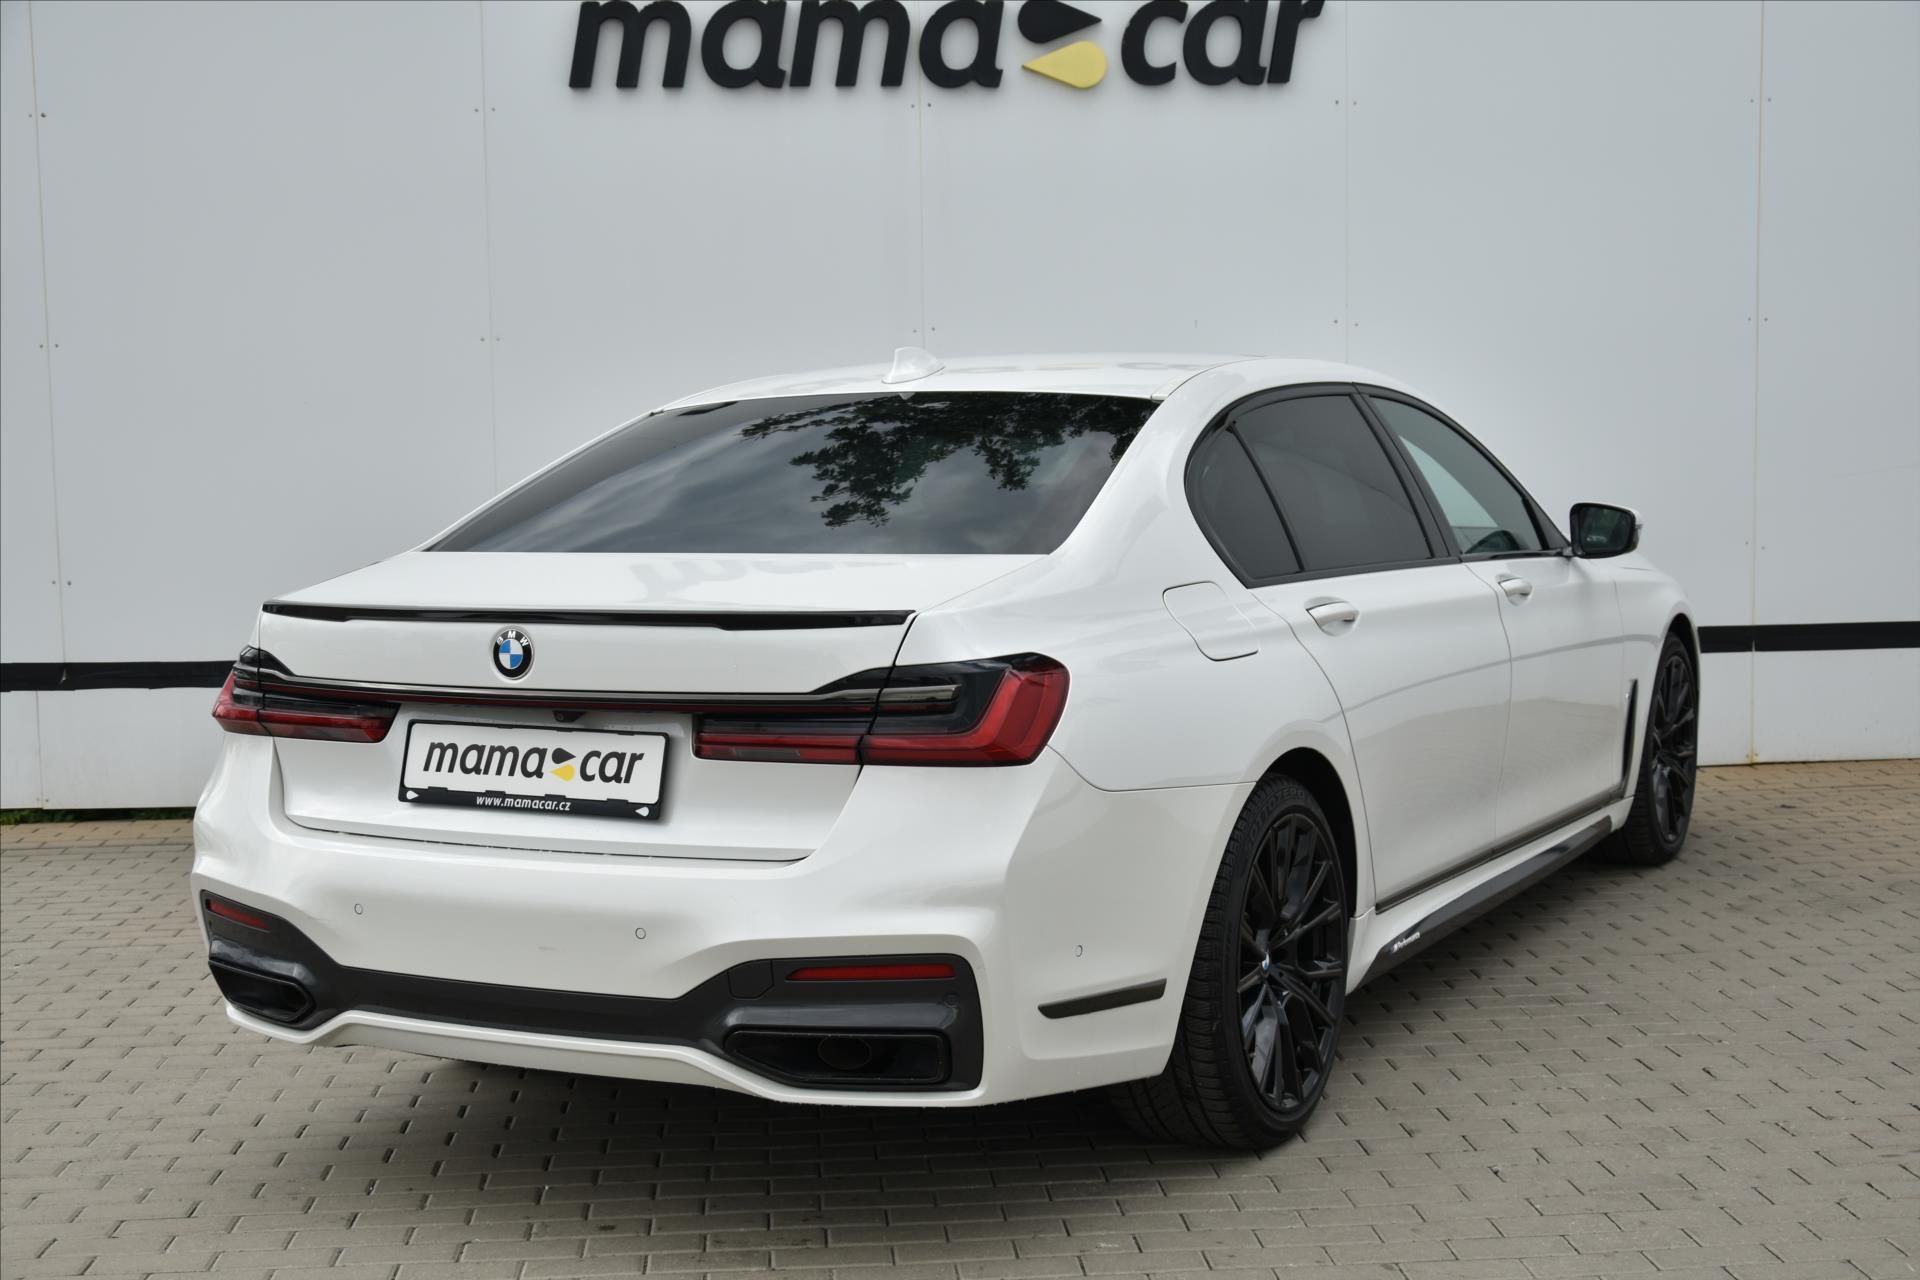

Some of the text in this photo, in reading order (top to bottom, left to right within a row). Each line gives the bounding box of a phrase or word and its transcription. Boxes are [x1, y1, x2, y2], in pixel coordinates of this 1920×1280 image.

[569, 0, 1325, 89] mama car
[496, 630, 529, 647] BMW
[423, 741, 645, 784] mama car
[476, 796, 571, 811] www.mamacar.cz
